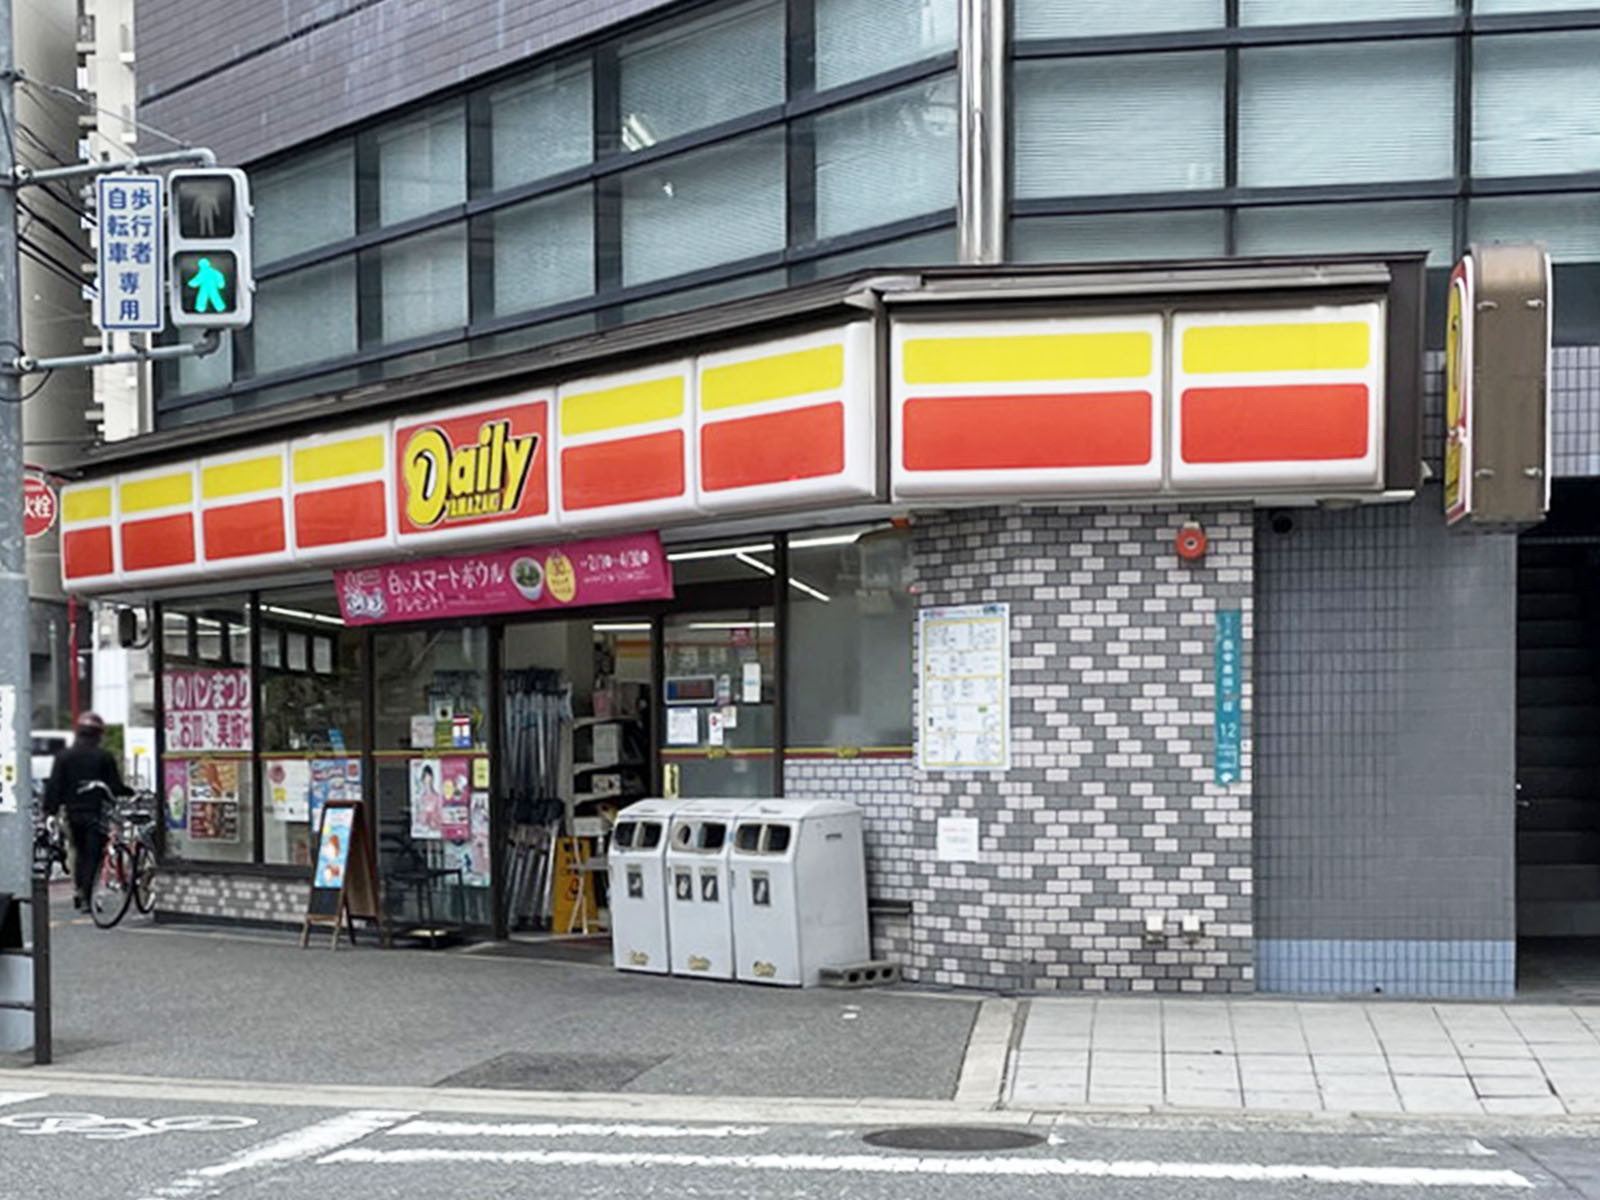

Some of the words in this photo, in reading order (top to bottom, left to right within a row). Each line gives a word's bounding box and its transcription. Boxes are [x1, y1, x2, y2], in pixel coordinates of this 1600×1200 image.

[107, 187, 129, 265] 自転車
[131, 187, 153, 265] 歩行者
[118, 271, 140, 322] 専用
[404, 421, 539, 526] Daily
[1219, 722, 1237, 738] 12
